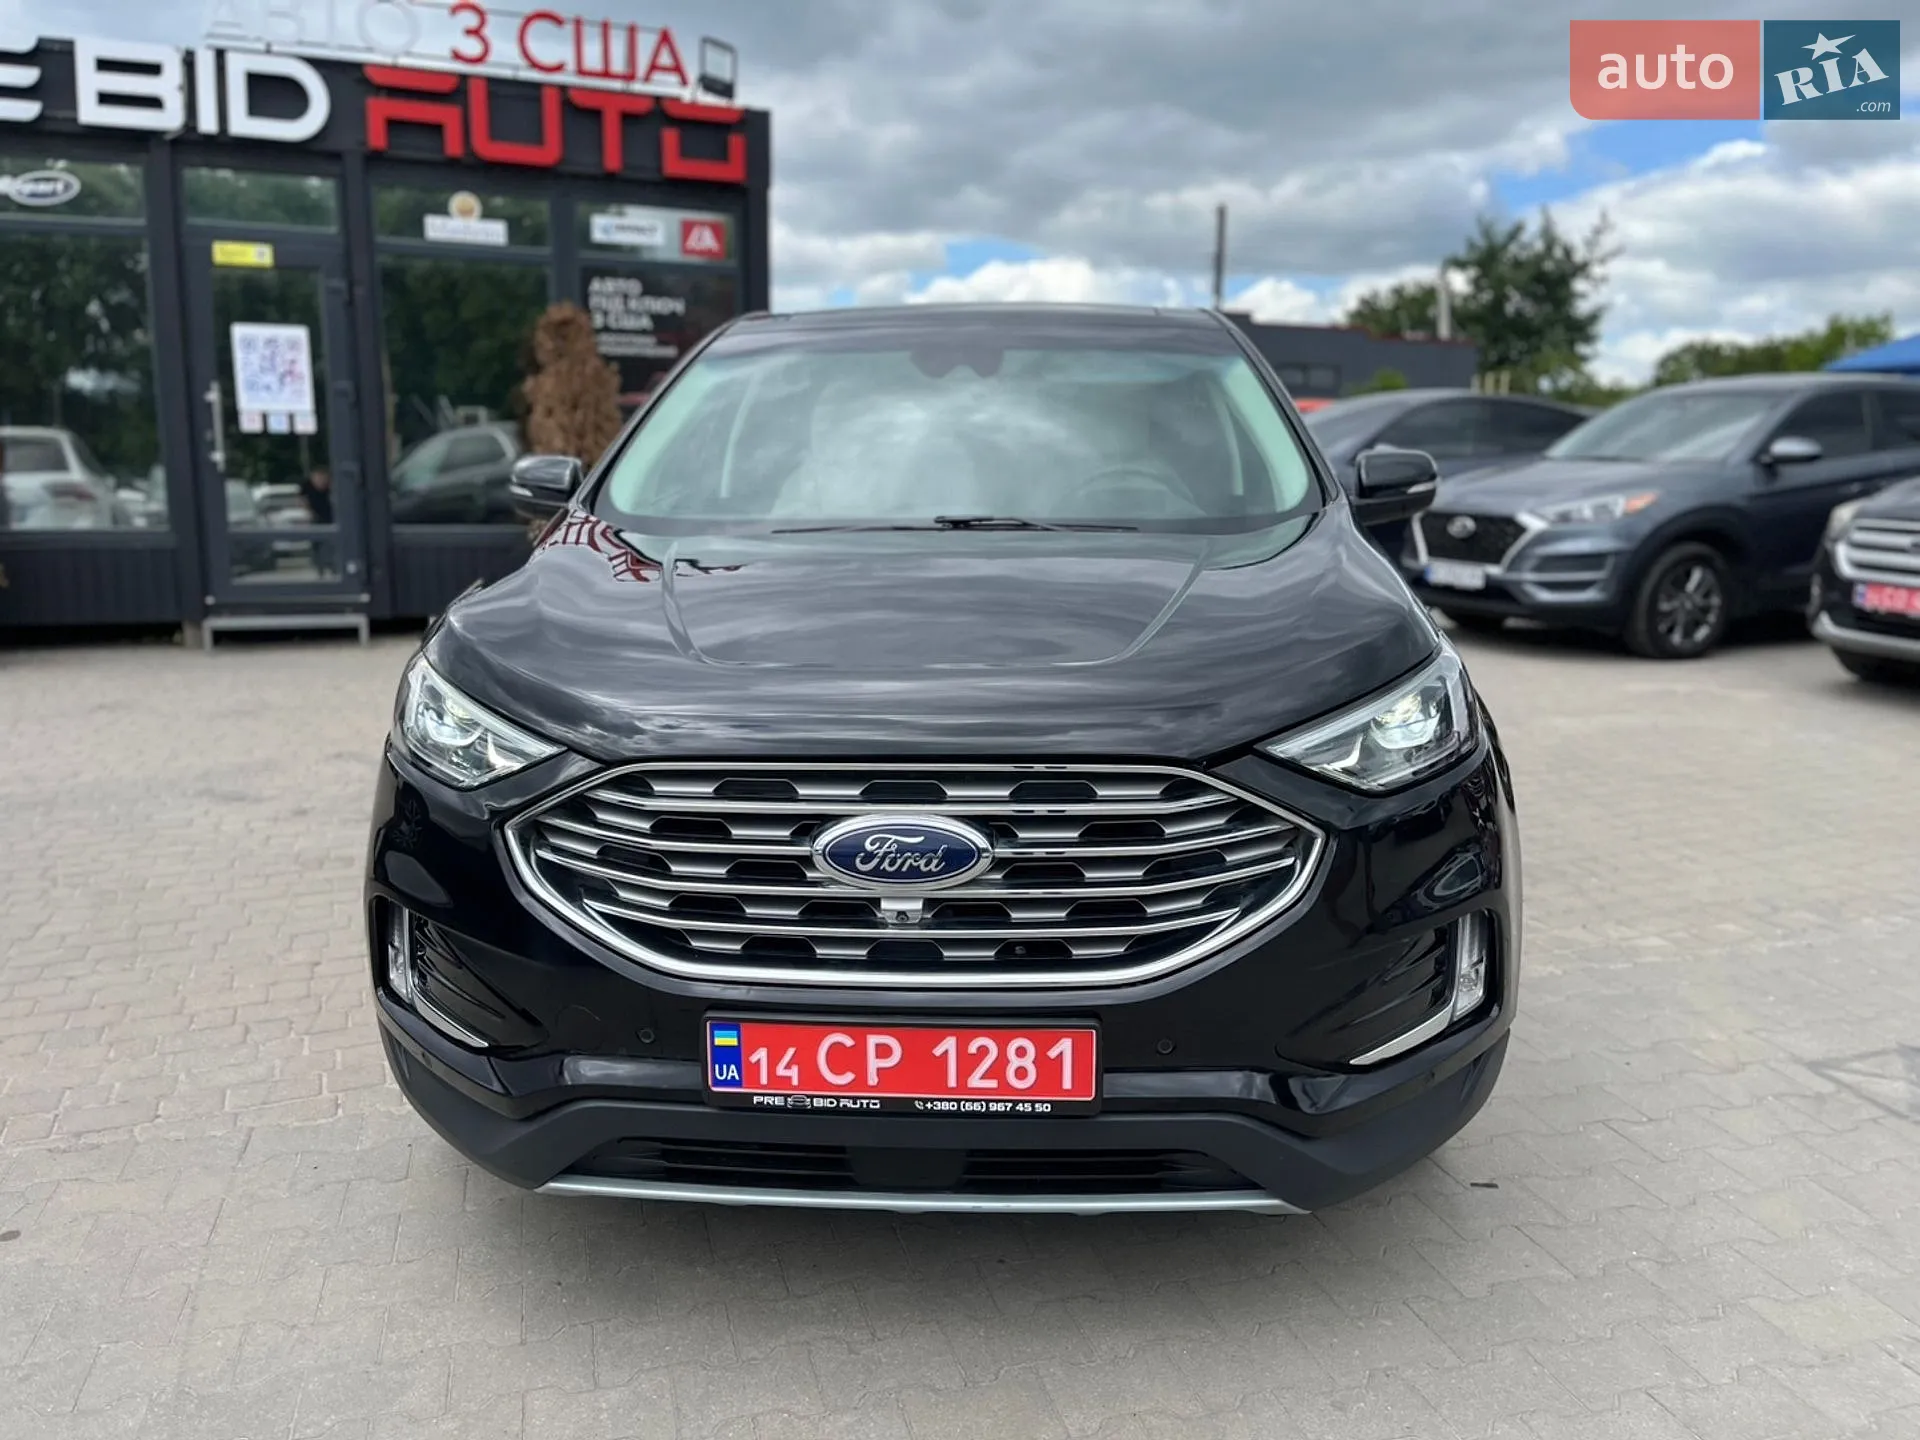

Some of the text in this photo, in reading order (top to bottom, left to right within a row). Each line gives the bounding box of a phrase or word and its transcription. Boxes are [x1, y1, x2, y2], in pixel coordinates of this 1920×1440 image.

[518, 11, 689, 86] США
[74, 37, 331, 142] BID
[363, 64, 747, 182] AUTO
[855, 833, 949, 873] Ford
[714, 1063, 740, 1081] UA
[748, 1032, 1074, 1090] 14 CP 1281
[753, 1095, 880, 1109] PRE BID AUTO
[925, 1101, 958, 1111] +380
[1015, 1102, 1032, 1112] 45
